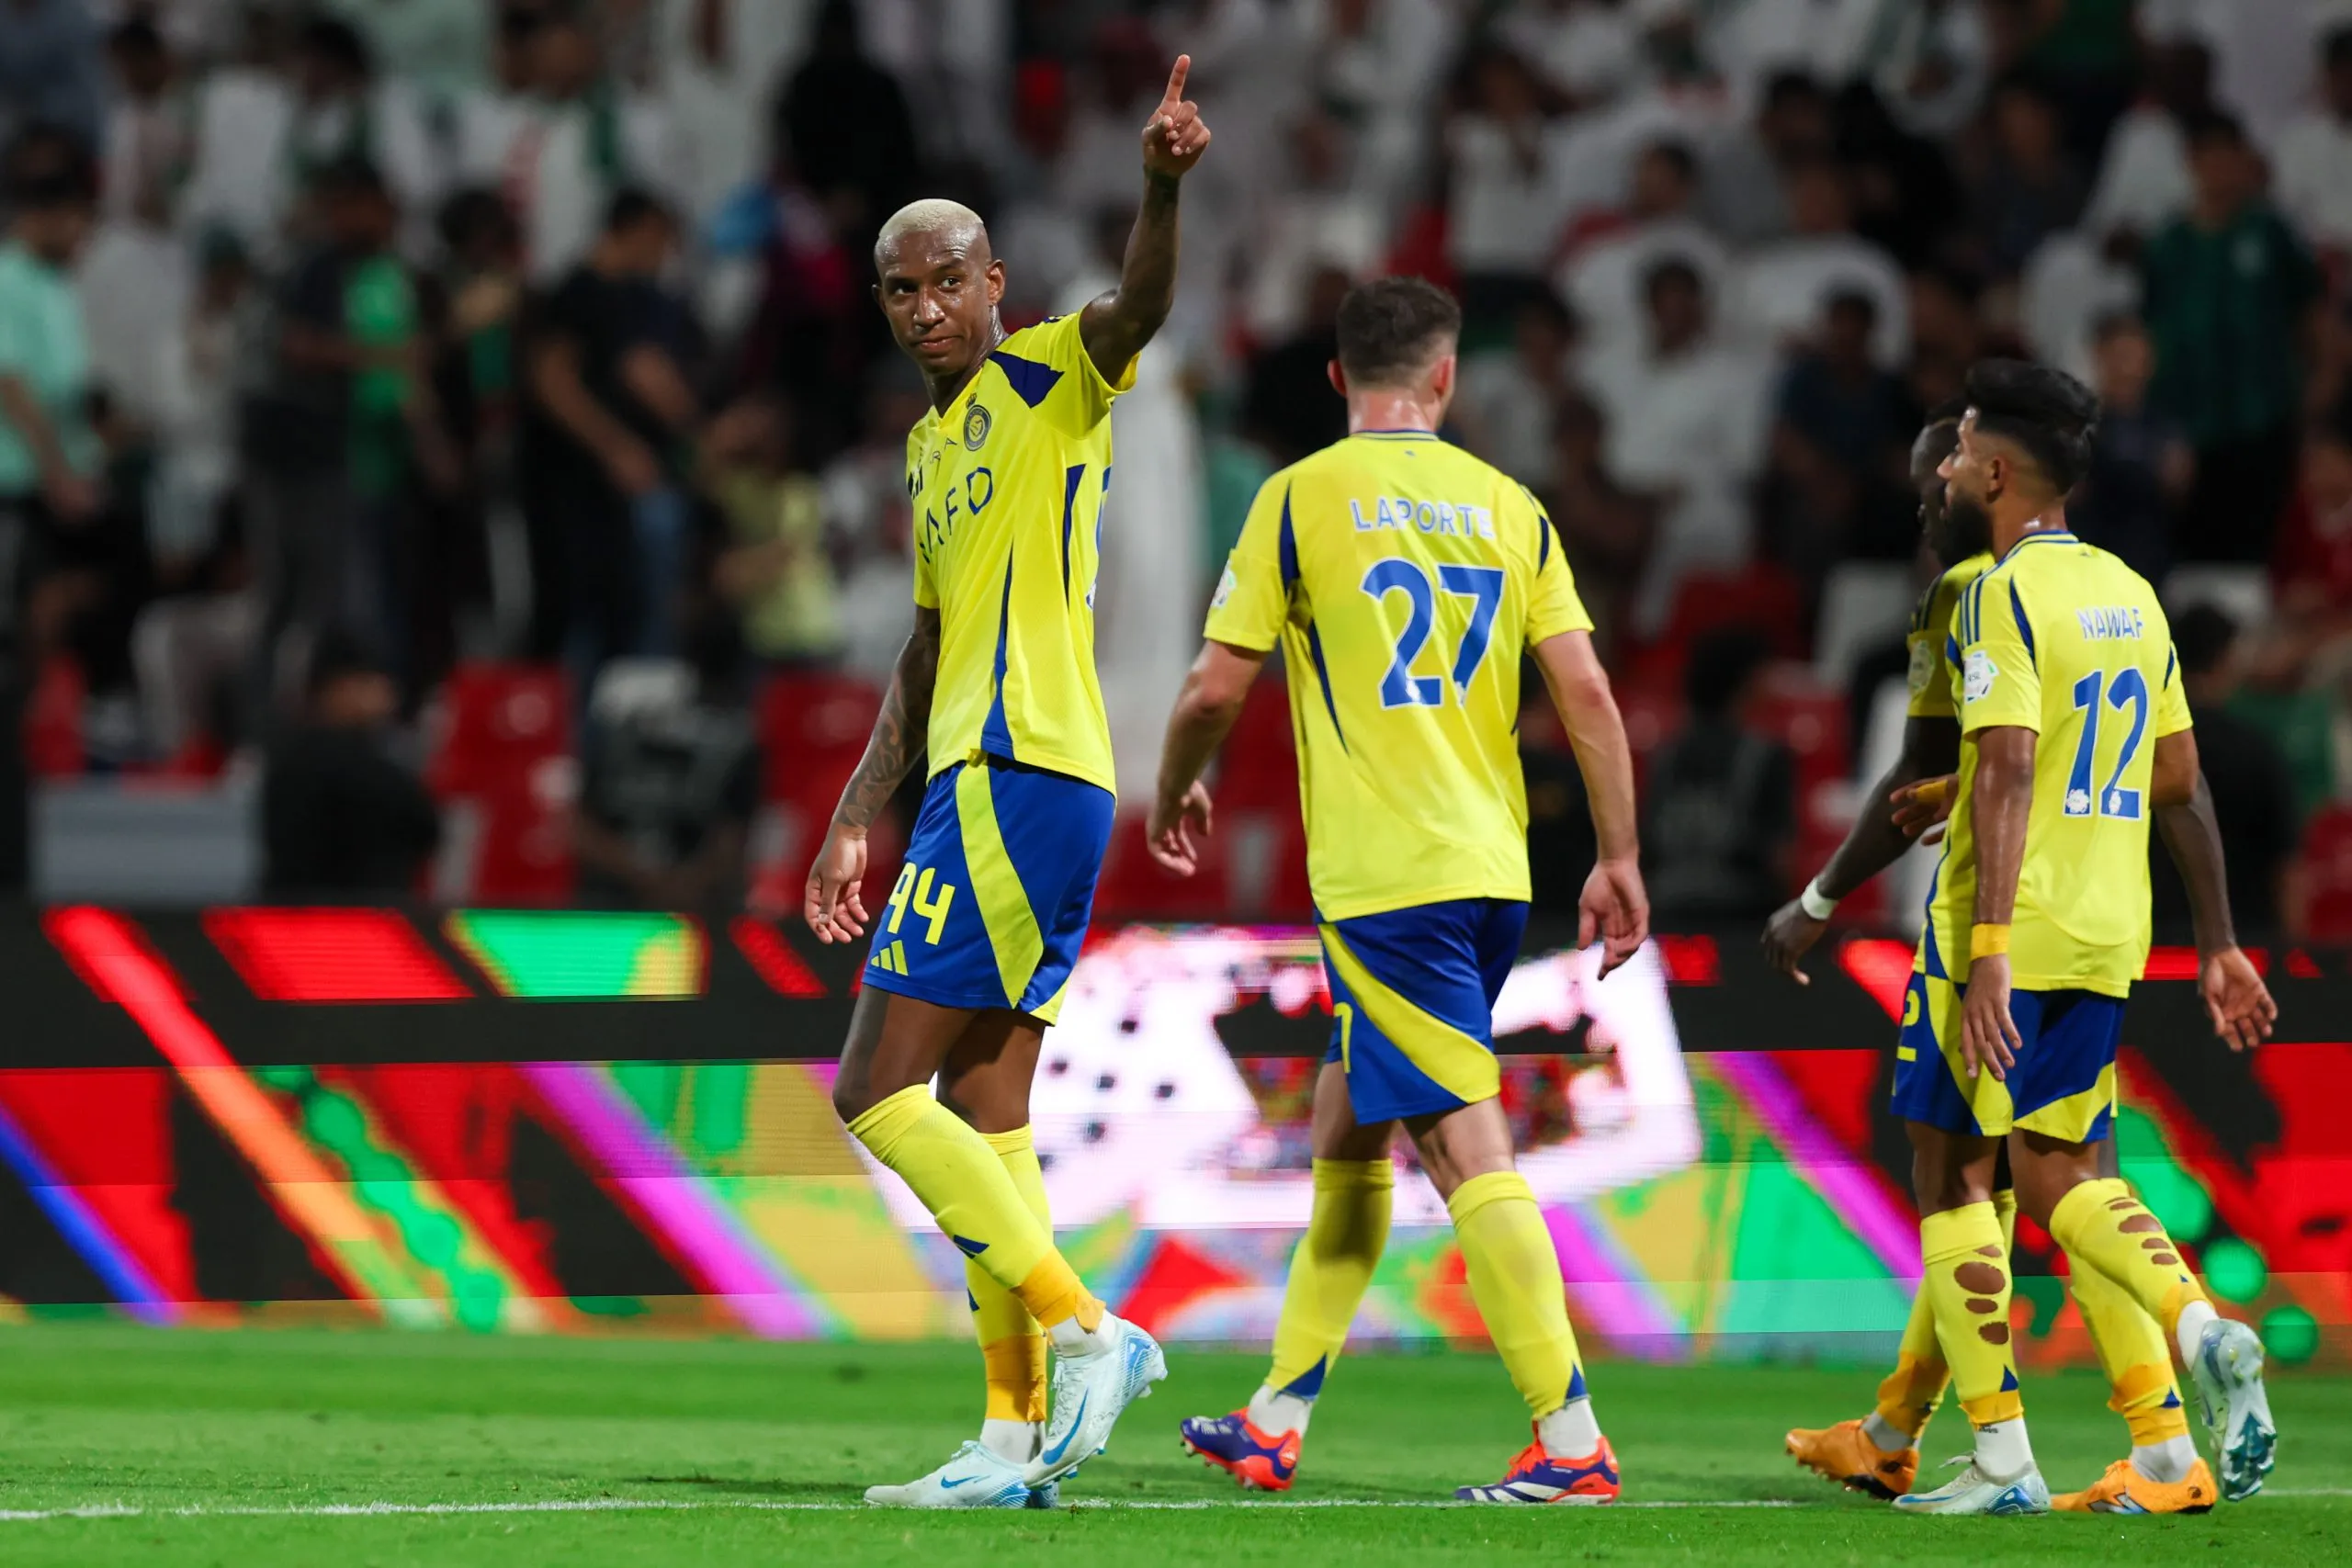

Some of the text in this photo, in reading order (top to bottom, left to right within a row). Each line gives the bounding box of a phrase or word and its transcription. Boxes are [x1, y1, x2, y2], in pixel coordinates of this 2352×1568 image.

[1349, 496, 1496, 539] LAPORTE
[1359, 557, 1506, 711] 27
[2075, 605, 2144, 641] NAWAF
[2063, 665, 2149, 821] 12
[887, 862, 956, 945] 94
